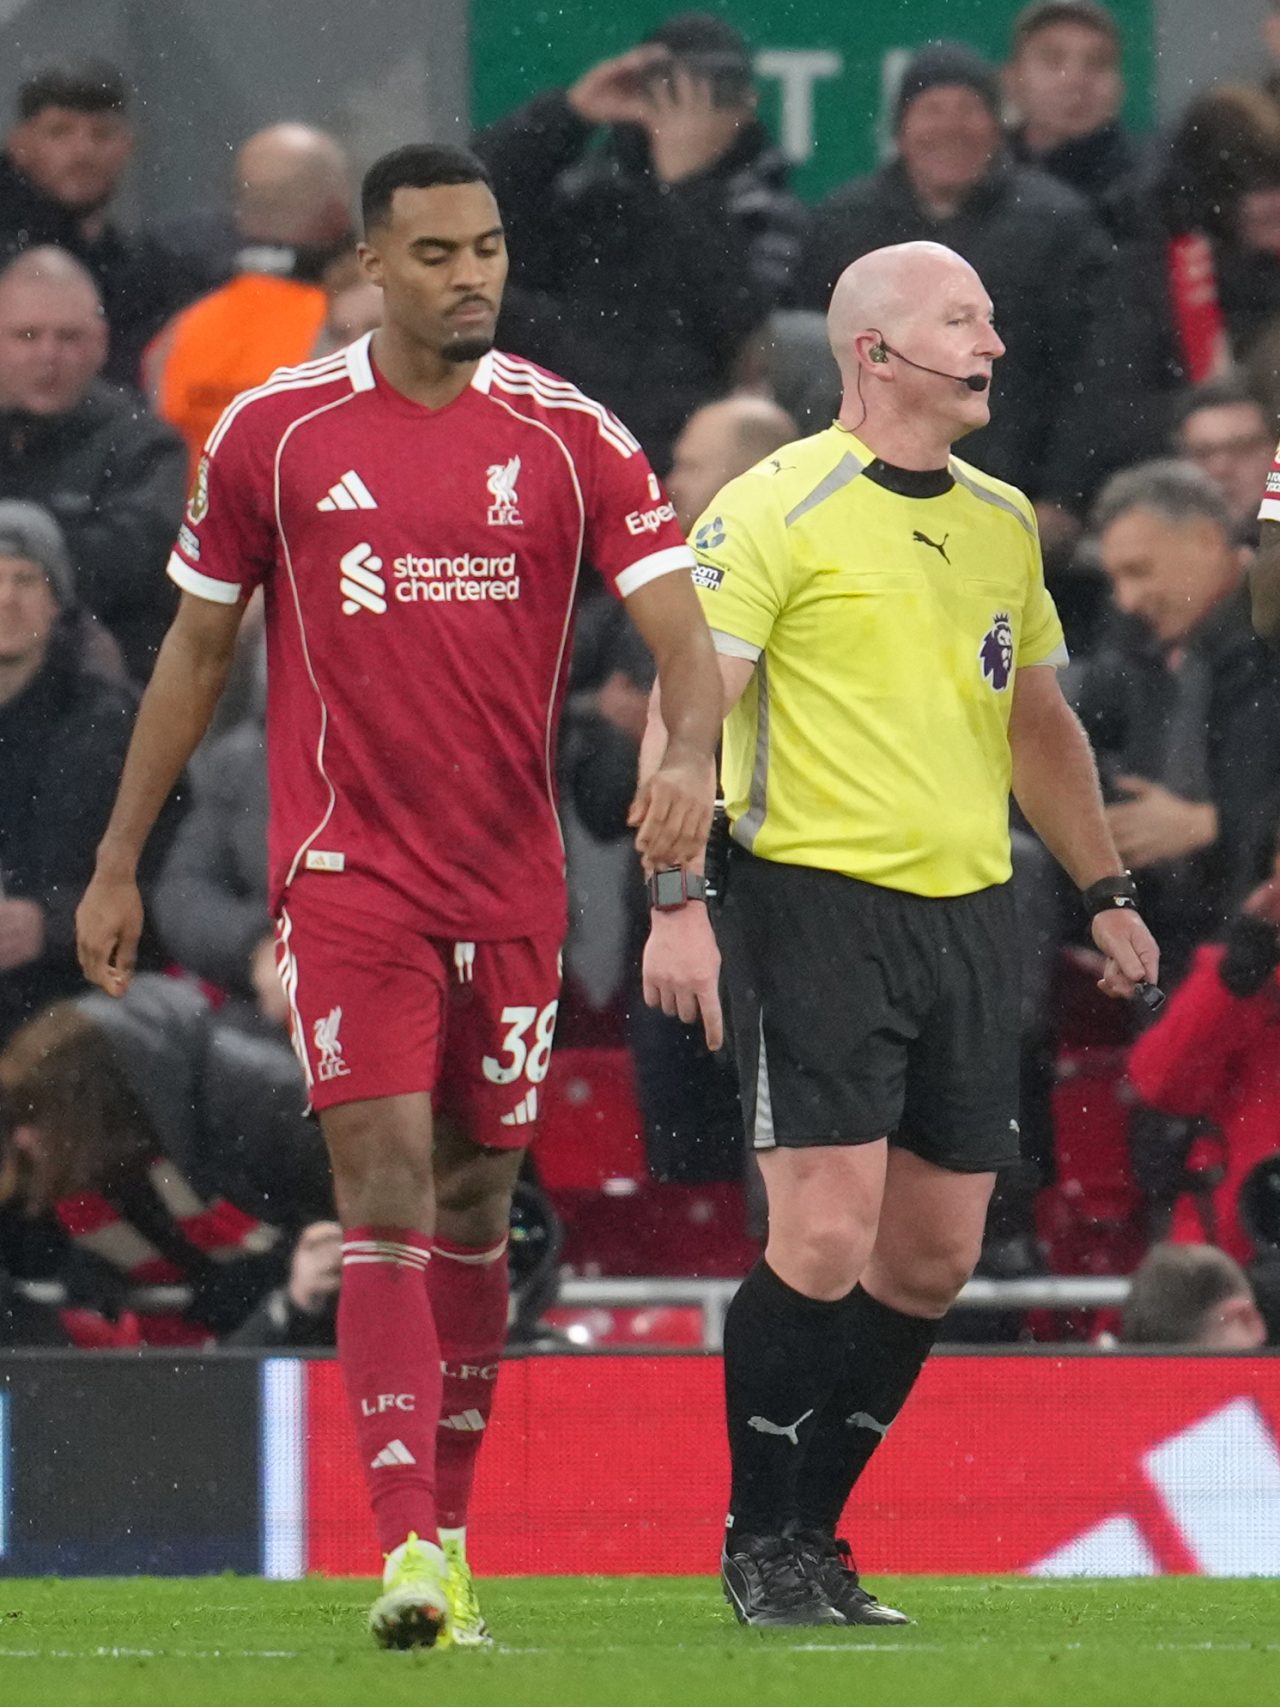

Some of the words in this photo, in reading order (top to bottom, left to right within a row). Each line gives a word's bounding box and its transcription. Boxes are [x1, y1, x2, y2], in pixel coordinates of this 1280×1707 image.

[393, 553, 516, 578] standard
[395, 576, 520, 602] chartered
[482, 999, 559, 1085] 38
[439, 1360, 499, 1380] LFC
[361, 1393, 416, 1417] LFC
